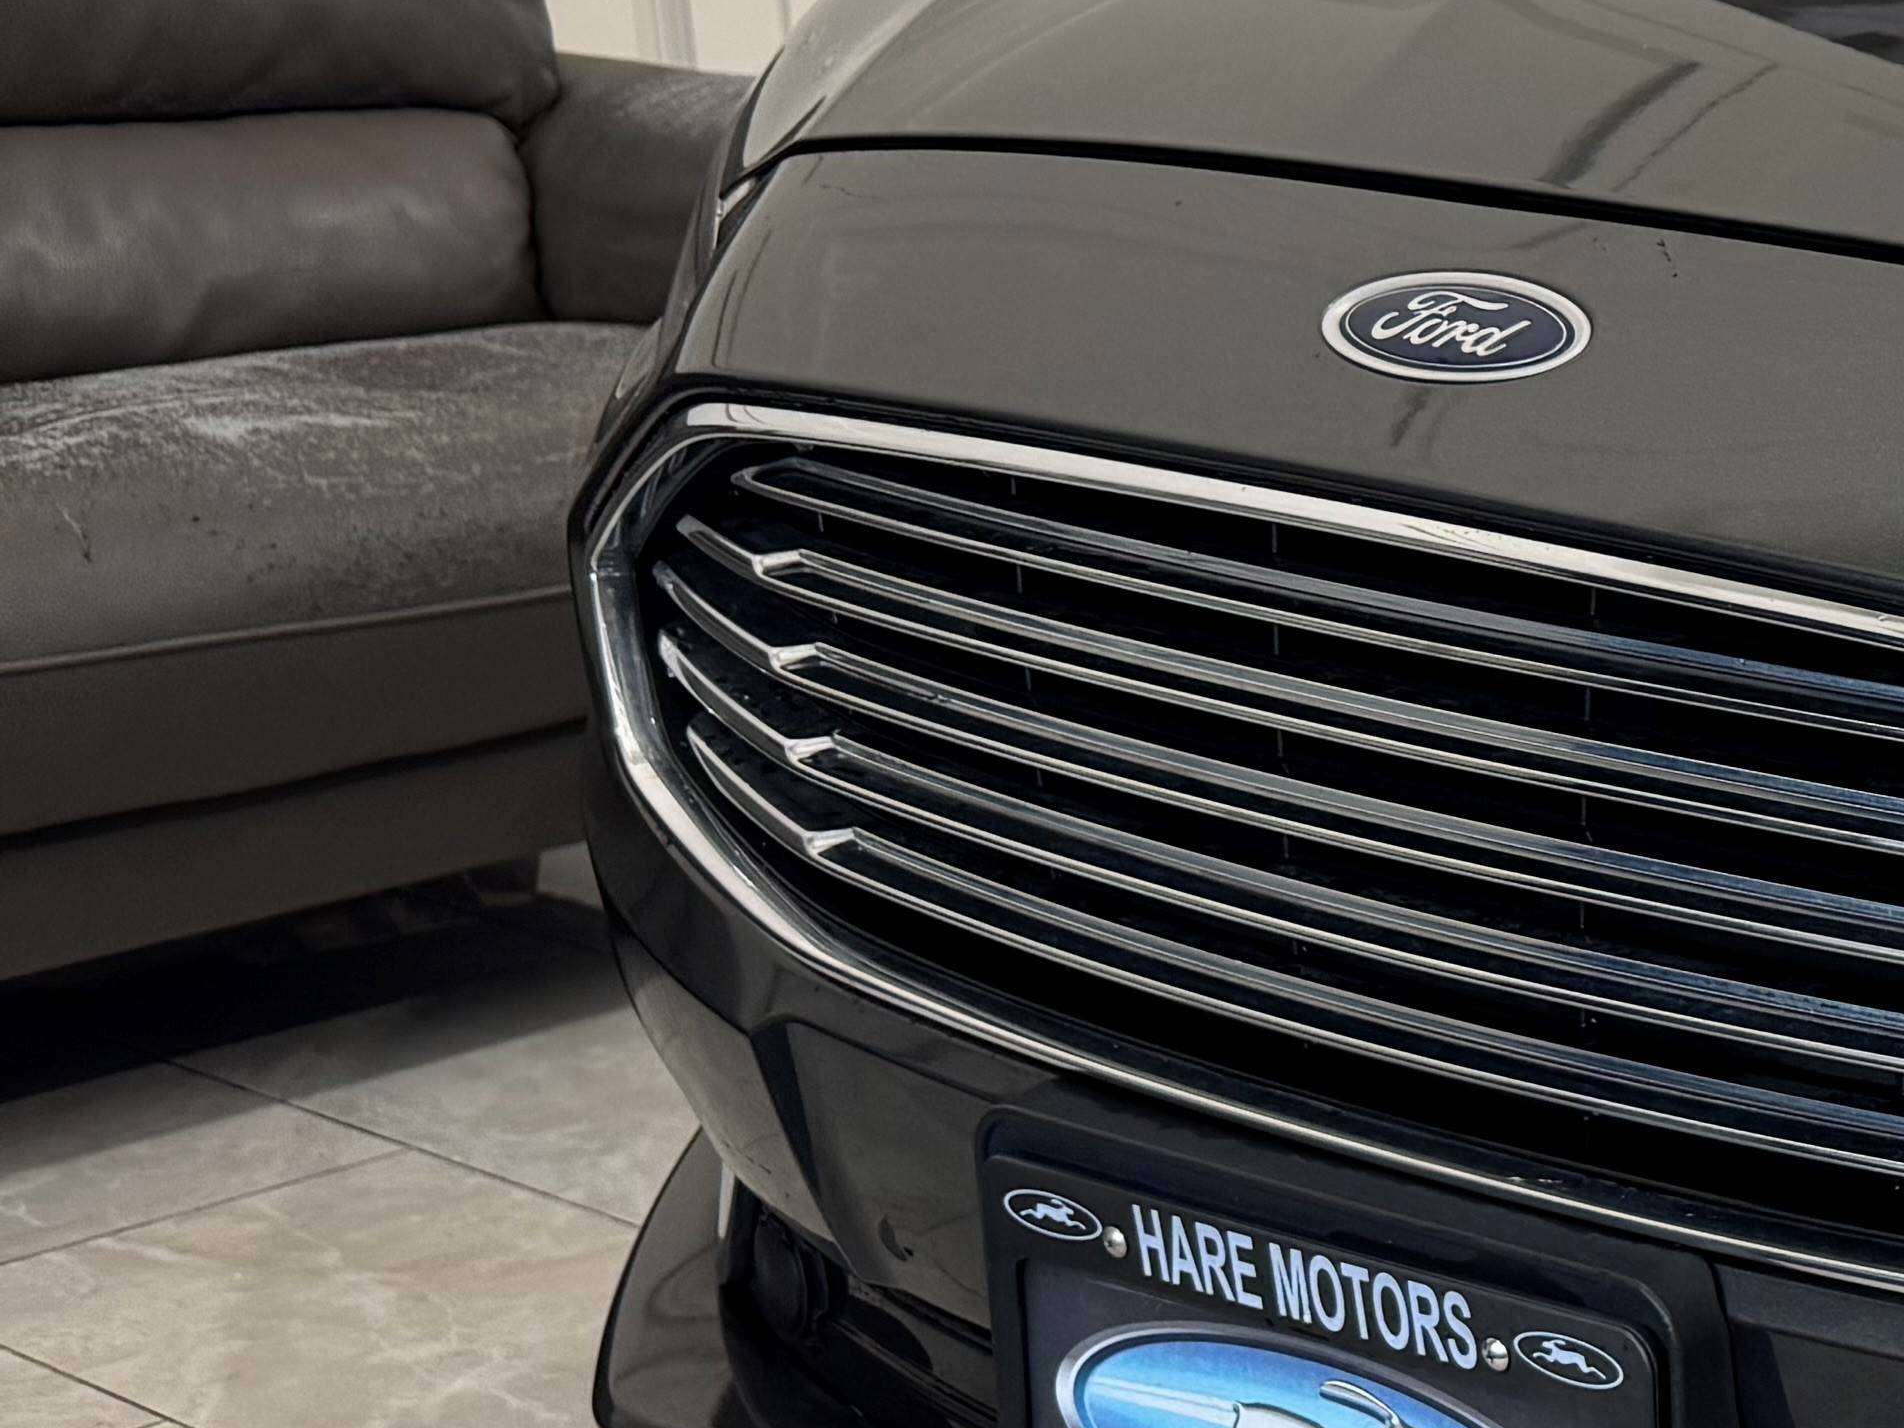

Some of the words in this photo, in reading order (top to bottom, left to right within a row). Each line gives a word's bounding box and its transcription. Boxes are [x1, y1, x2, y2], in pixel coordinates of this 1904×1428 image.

[1371, 291, 1532, 357] Ford
[1131, 1204, 1263, 1310] HARE
[1268, 1242, 1478, 1371] MOTORS
